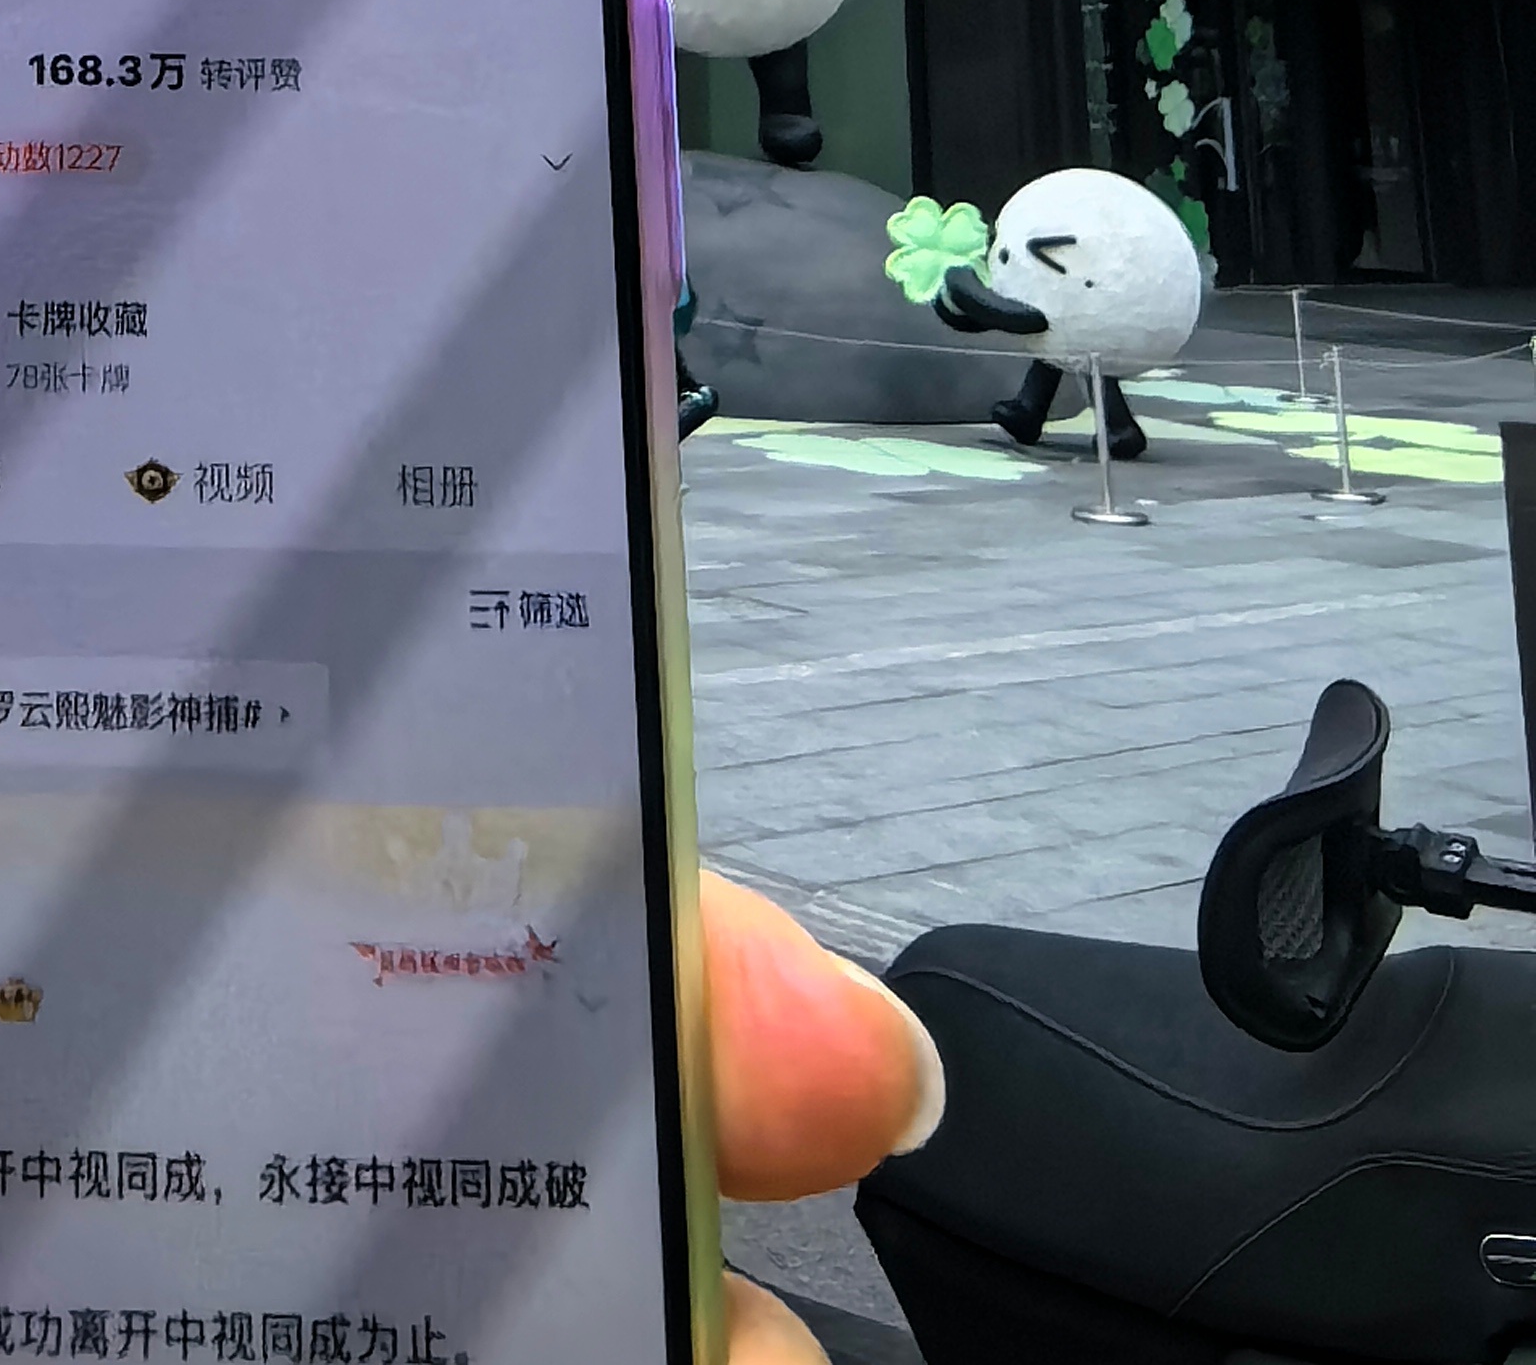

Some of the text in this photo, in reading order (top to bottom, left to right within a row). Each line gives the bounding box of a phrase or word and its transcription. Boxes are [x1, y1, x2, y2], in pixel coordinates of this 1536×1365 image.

[27, 53, 187, 91] 168.3万
[200, 57, 303, 93] 转评赞
[6, 299, 148, 338] 卡牌收藏
[193, 461, 275, 505] 视频
[397, 463, 479, 509] 相册
[519, 591, 590, 630] 筛选
